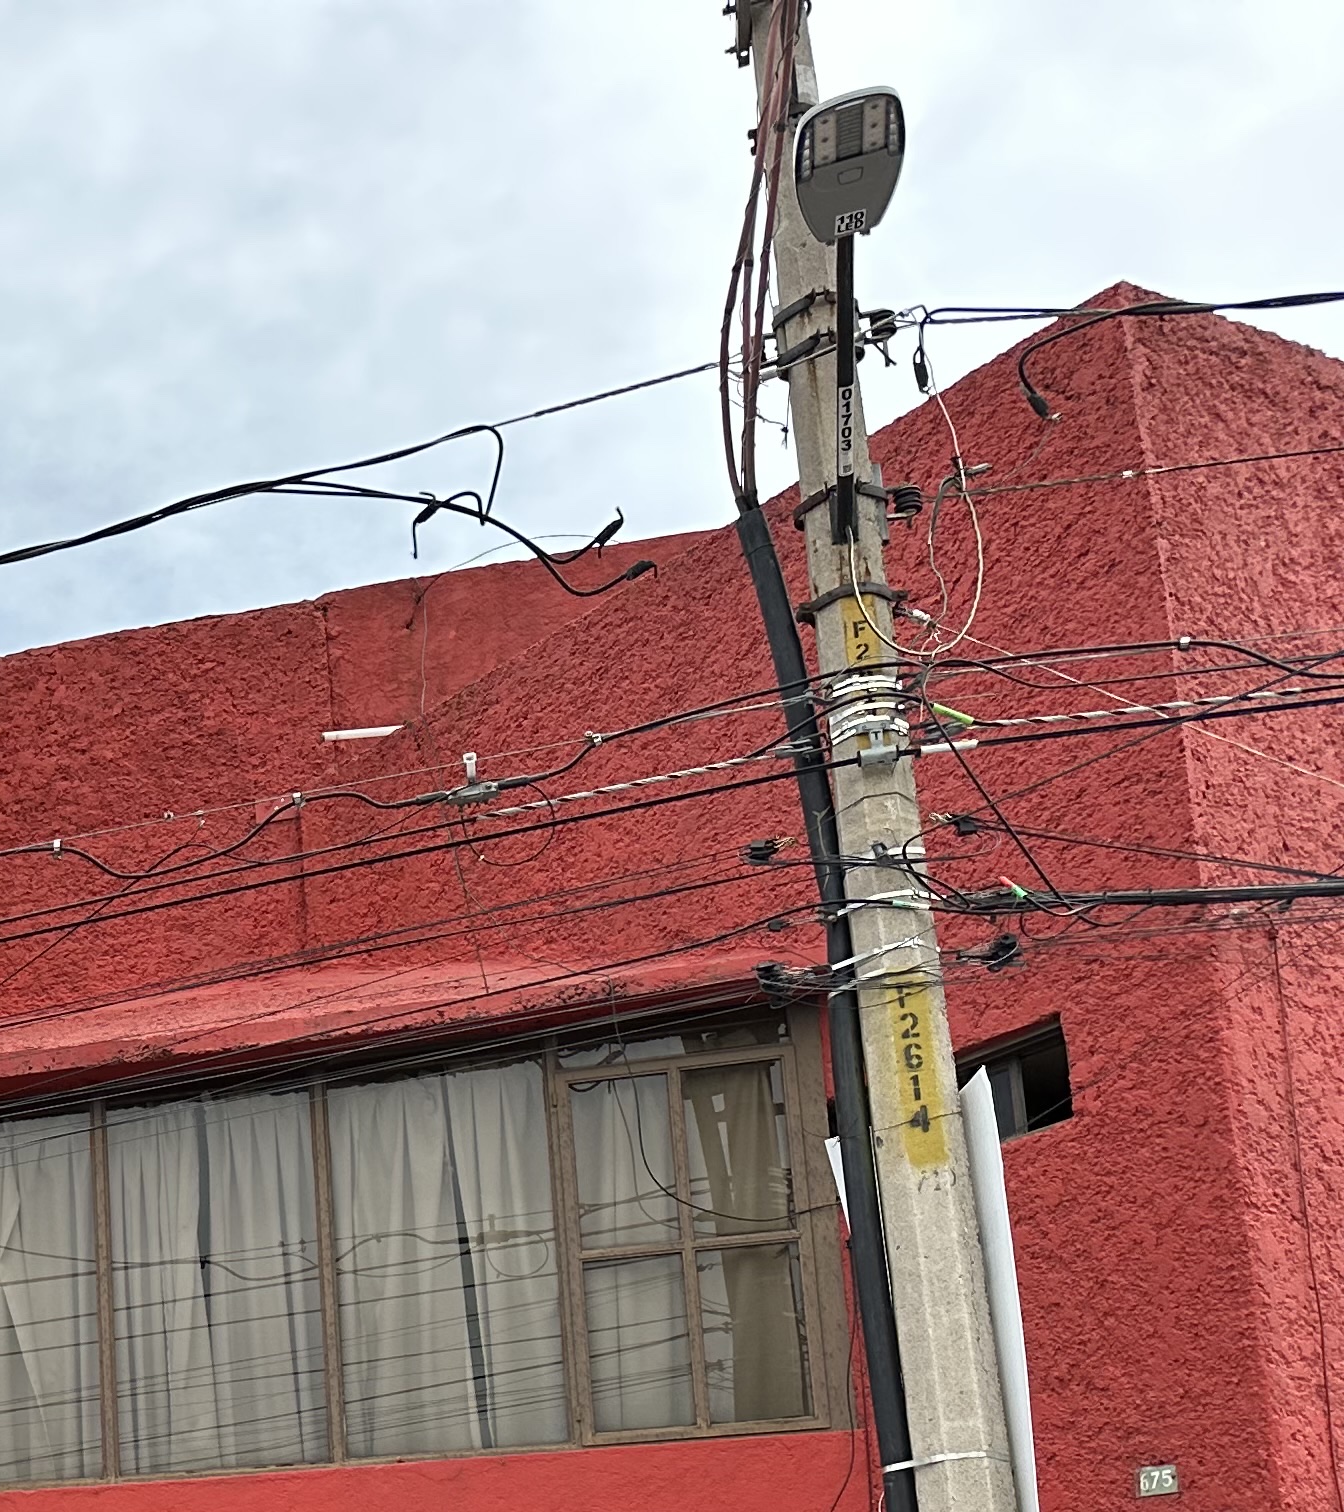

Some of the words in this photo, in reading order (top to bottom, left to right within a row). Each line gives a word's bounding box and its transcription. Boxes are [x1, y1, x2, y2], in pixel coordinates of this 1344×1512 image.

[836, 210, 865, 225] 110
[837, 219, 864, 234] LED
[841, 388, 853, 451] 01703
[1140, 1469, 1173, 1491] 675
